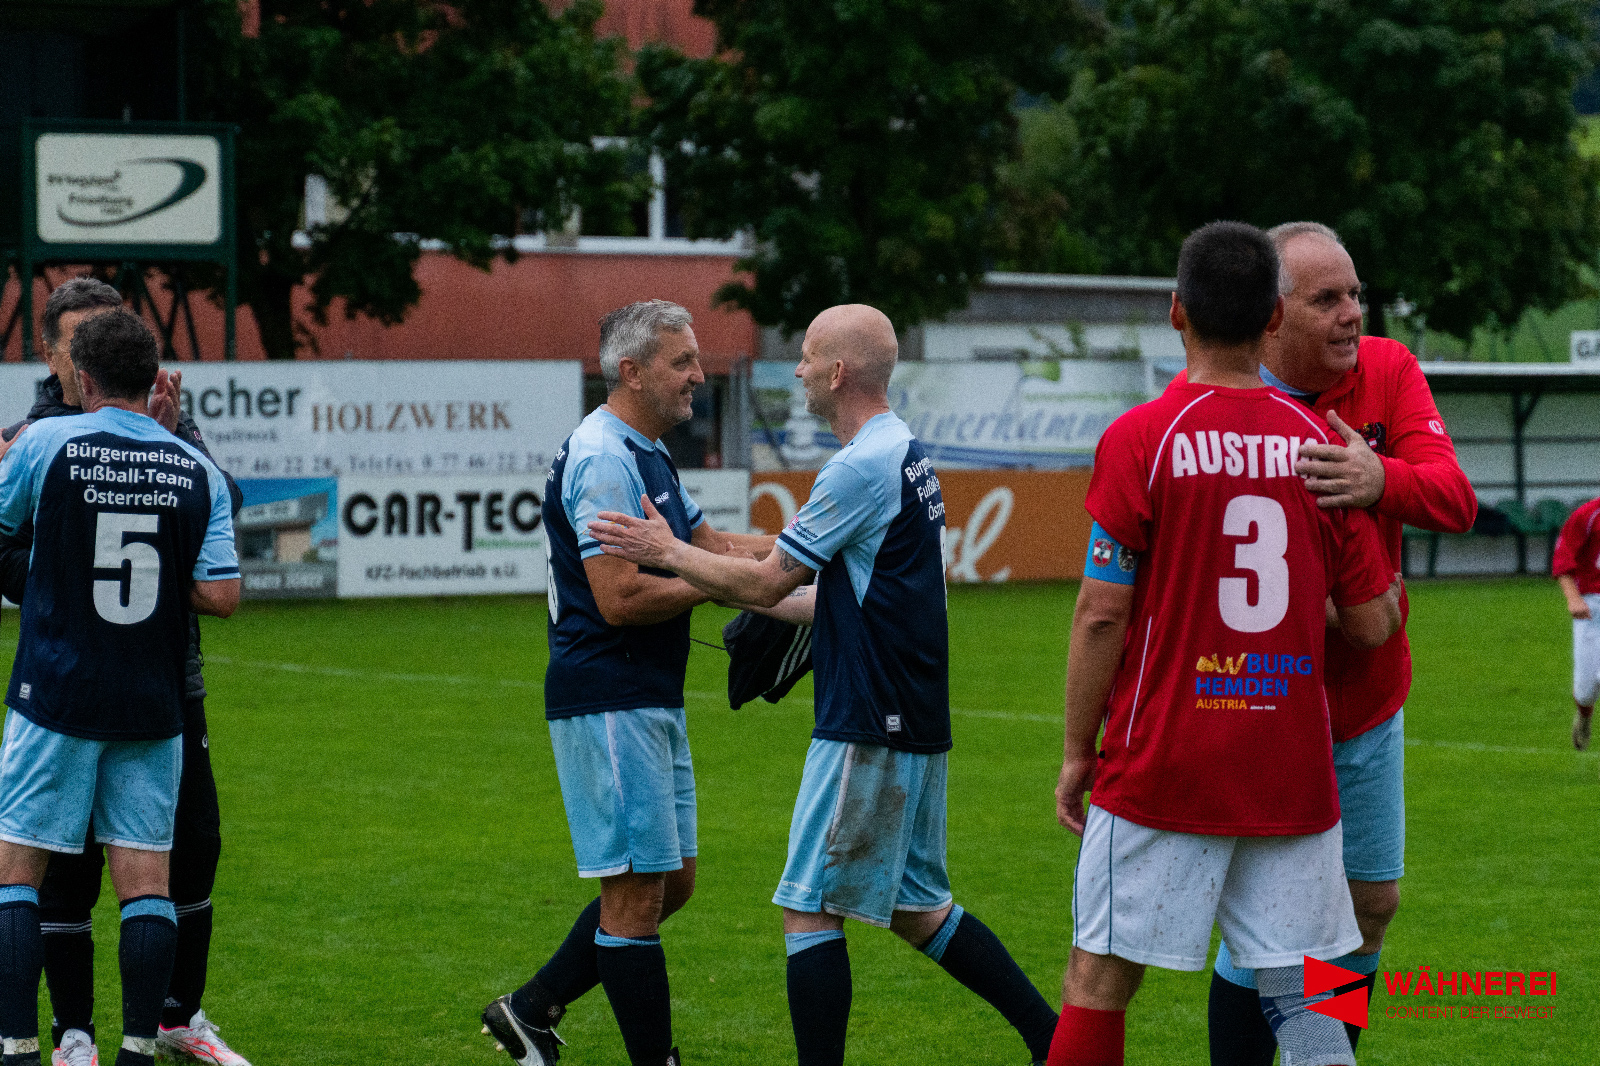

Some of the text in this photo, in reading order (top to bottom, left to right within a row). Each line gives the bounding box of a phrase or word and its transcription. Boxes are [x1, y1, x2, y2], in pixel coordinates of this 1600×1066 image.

[311, 402, 515, 432] HOLZWERK
[66, 442, 197, 470] Bürgermeister
[70, 465, 193, 490] Fußball-Team
[83, 484, 178, 508] Österreich
[342, 490, 543, 551] CAR-TEC
[92, 512, 160, 625] 5
[1218, 495, 1289, 633] 3
[1195, 677, 1289, 697] HEMDEN
[1195, 698, 1248, 710] AUSTRIA
